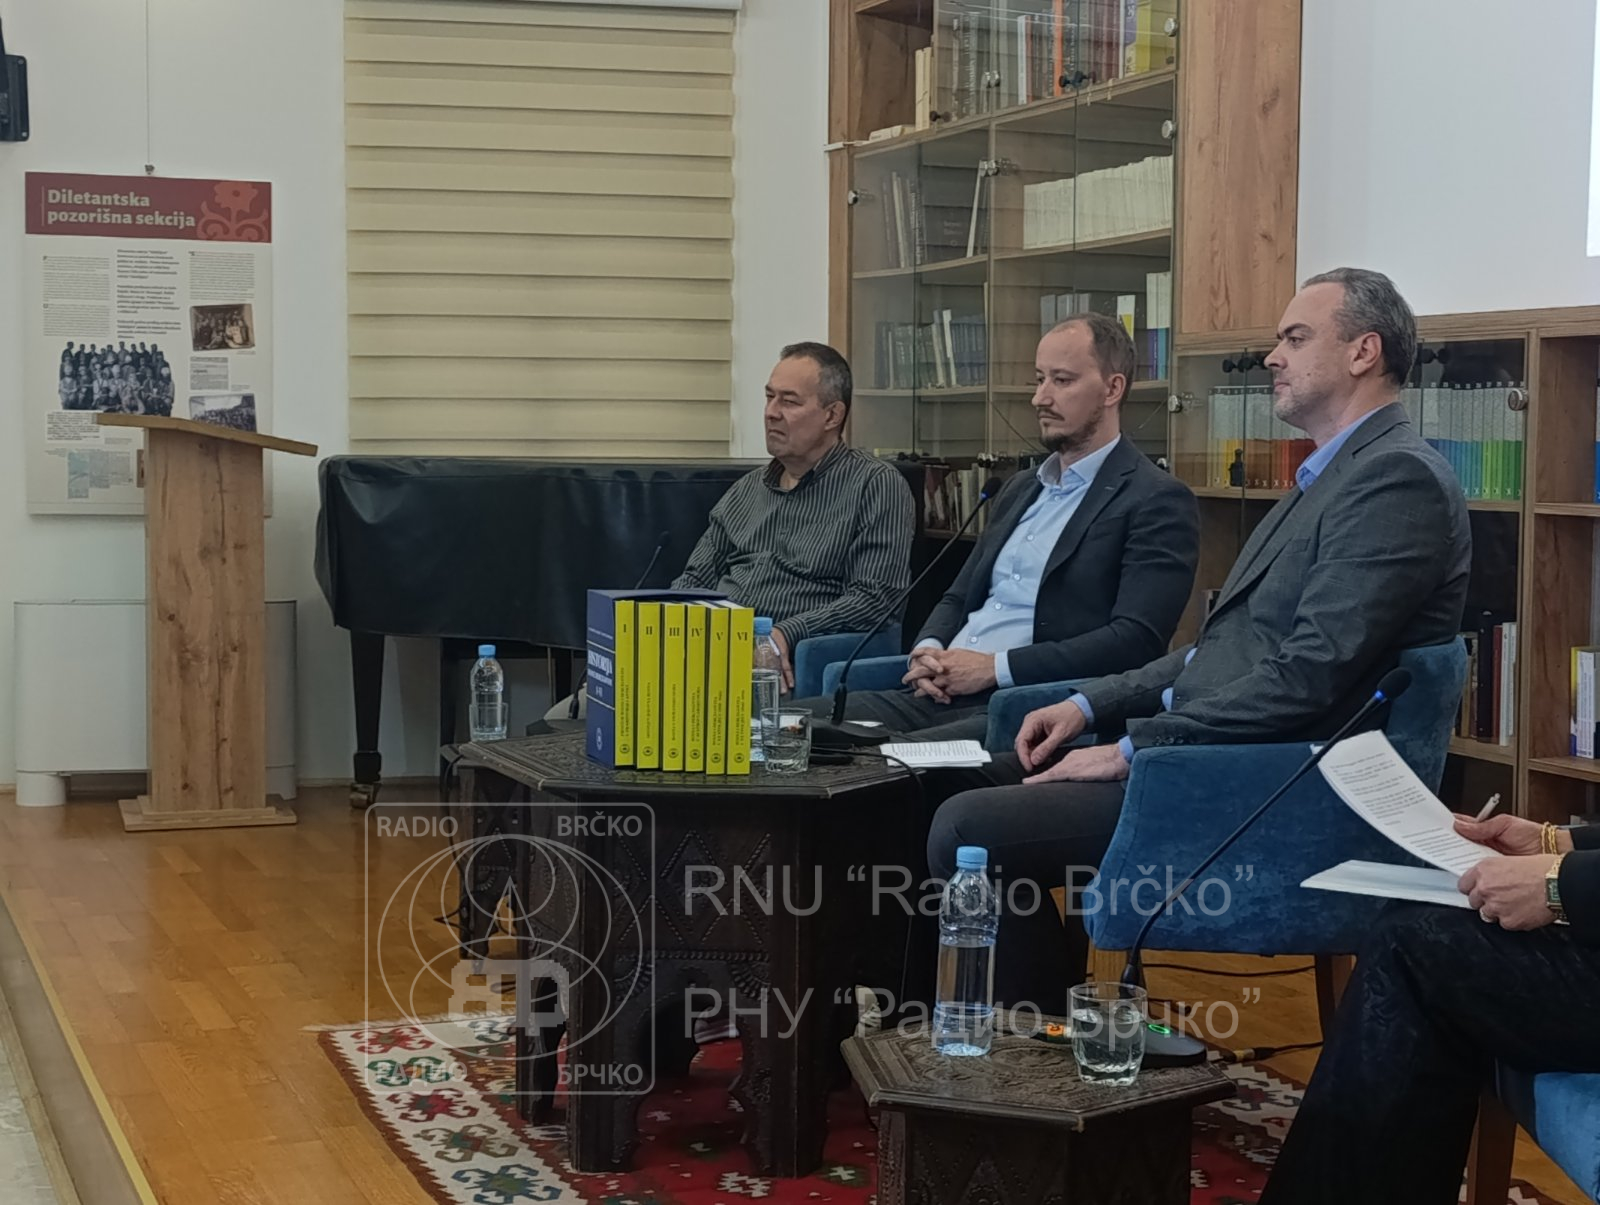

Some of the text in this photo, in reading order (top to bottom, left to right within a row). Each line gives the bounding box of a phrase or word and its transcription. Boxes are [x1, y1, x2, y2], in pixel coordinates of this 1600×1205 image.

[47, 188, 151, 207] Diletantska
[47, 208, 196, 229] pozorišna sekcija
[645, 625, 654, 636] II
[668, 627, 681, 637] III
[690, 627, 704, 638] IV
[715, 631, 724, 641] V
[736, 631, 749, 641] VI
